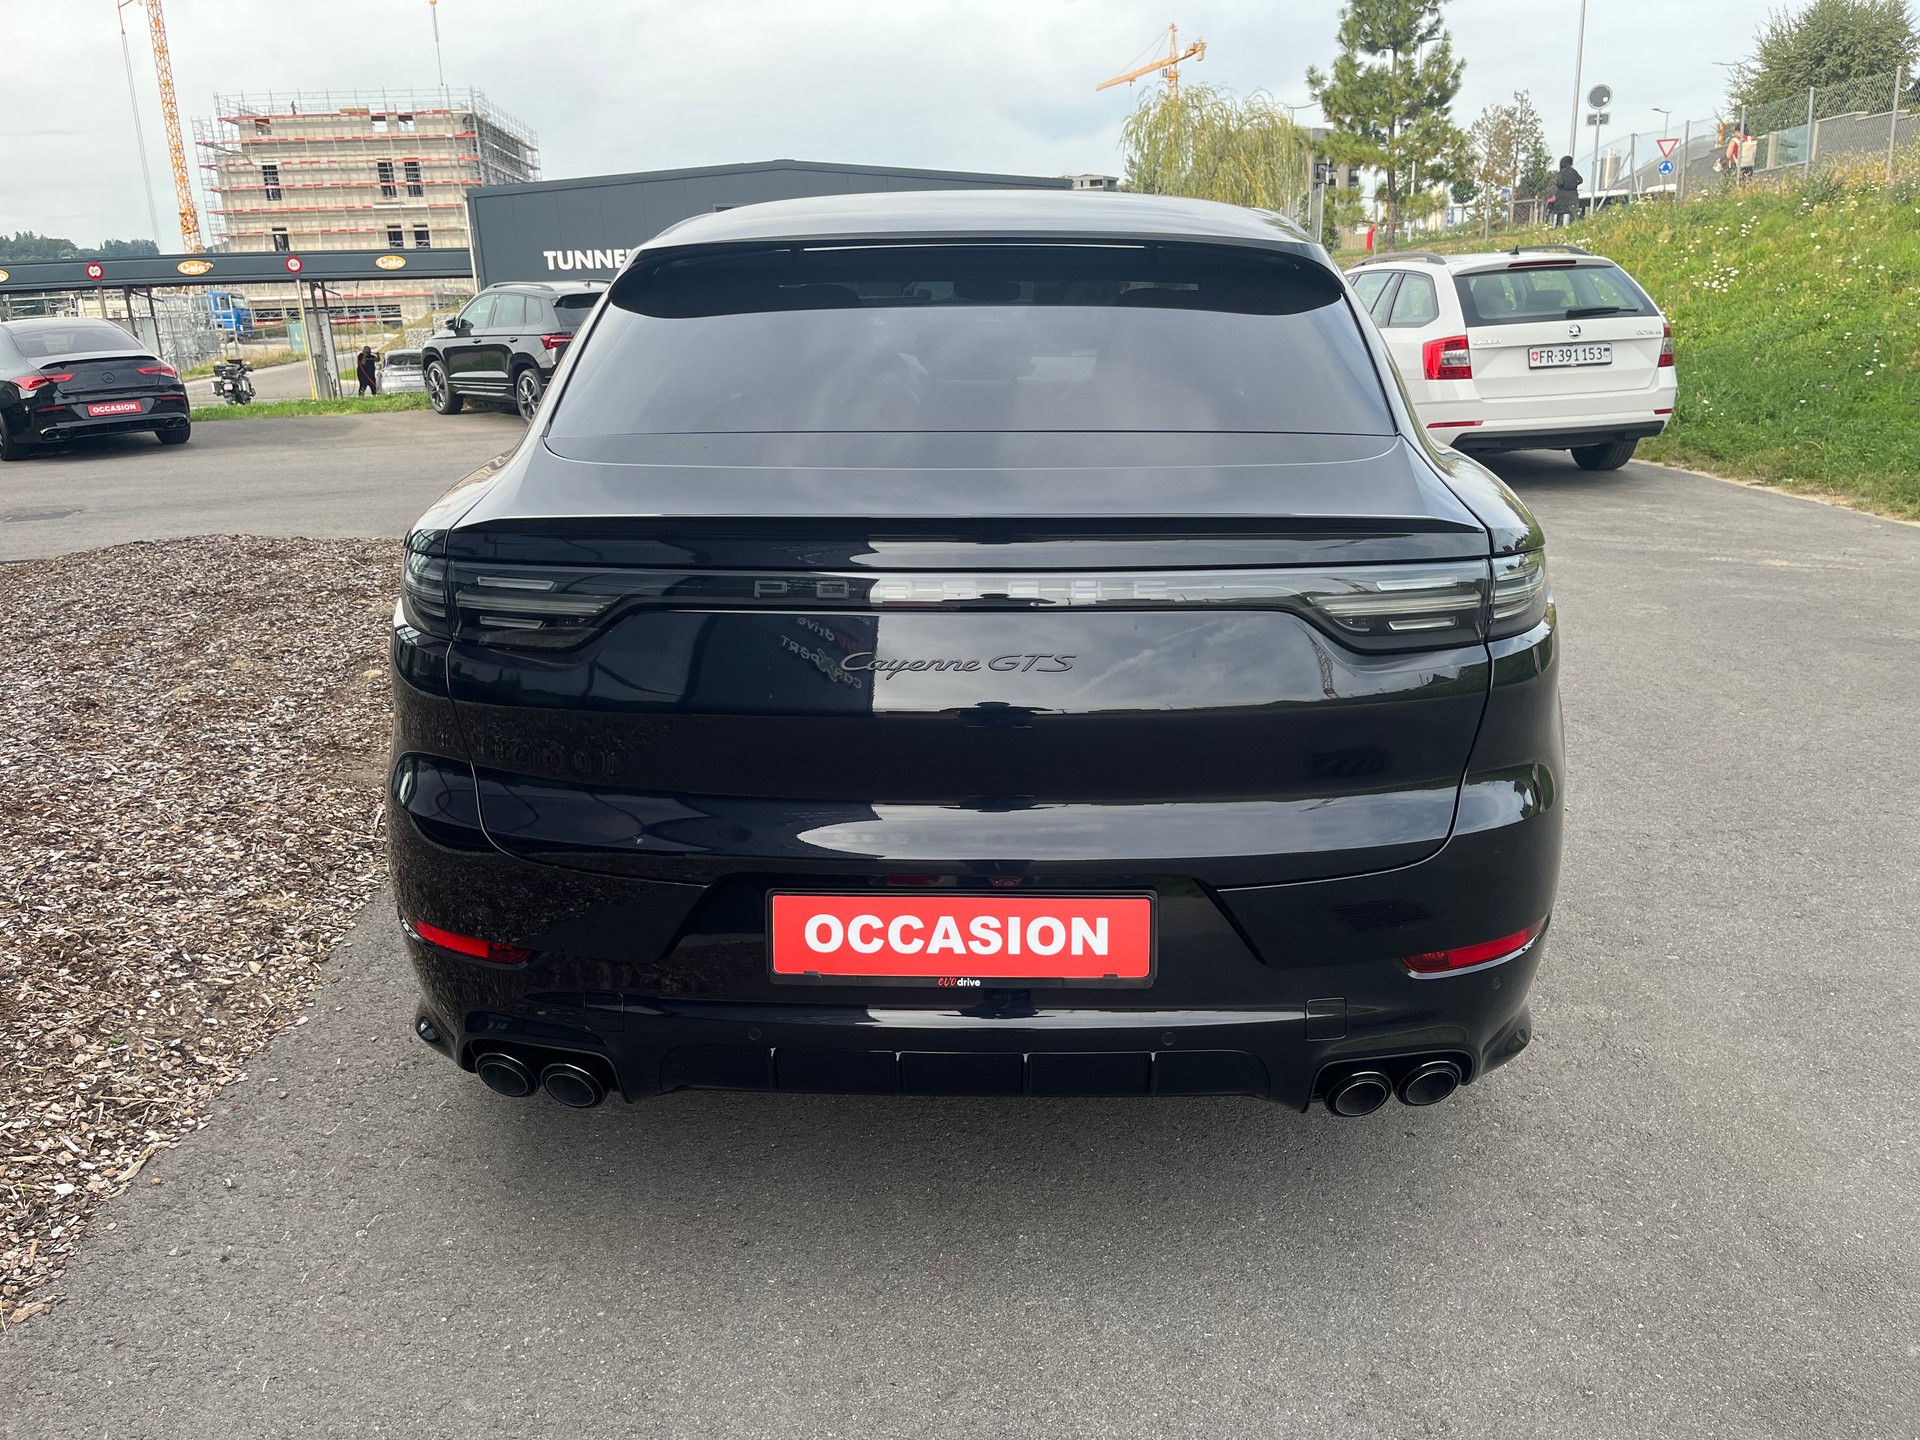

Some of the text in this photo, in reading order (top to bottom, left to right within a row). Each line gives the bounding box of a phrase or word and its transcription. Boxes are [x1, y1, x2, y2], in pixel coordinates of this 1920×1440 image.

[543, 249, 632, 271] TUNNE
[93, 403, 137, 413] OCCASION
[753, 579, 1168, 601] PORSCHE
[839, 651, 1078, 680] Cayenne GTS
[804, 913, 1109, 956] OCCASION
